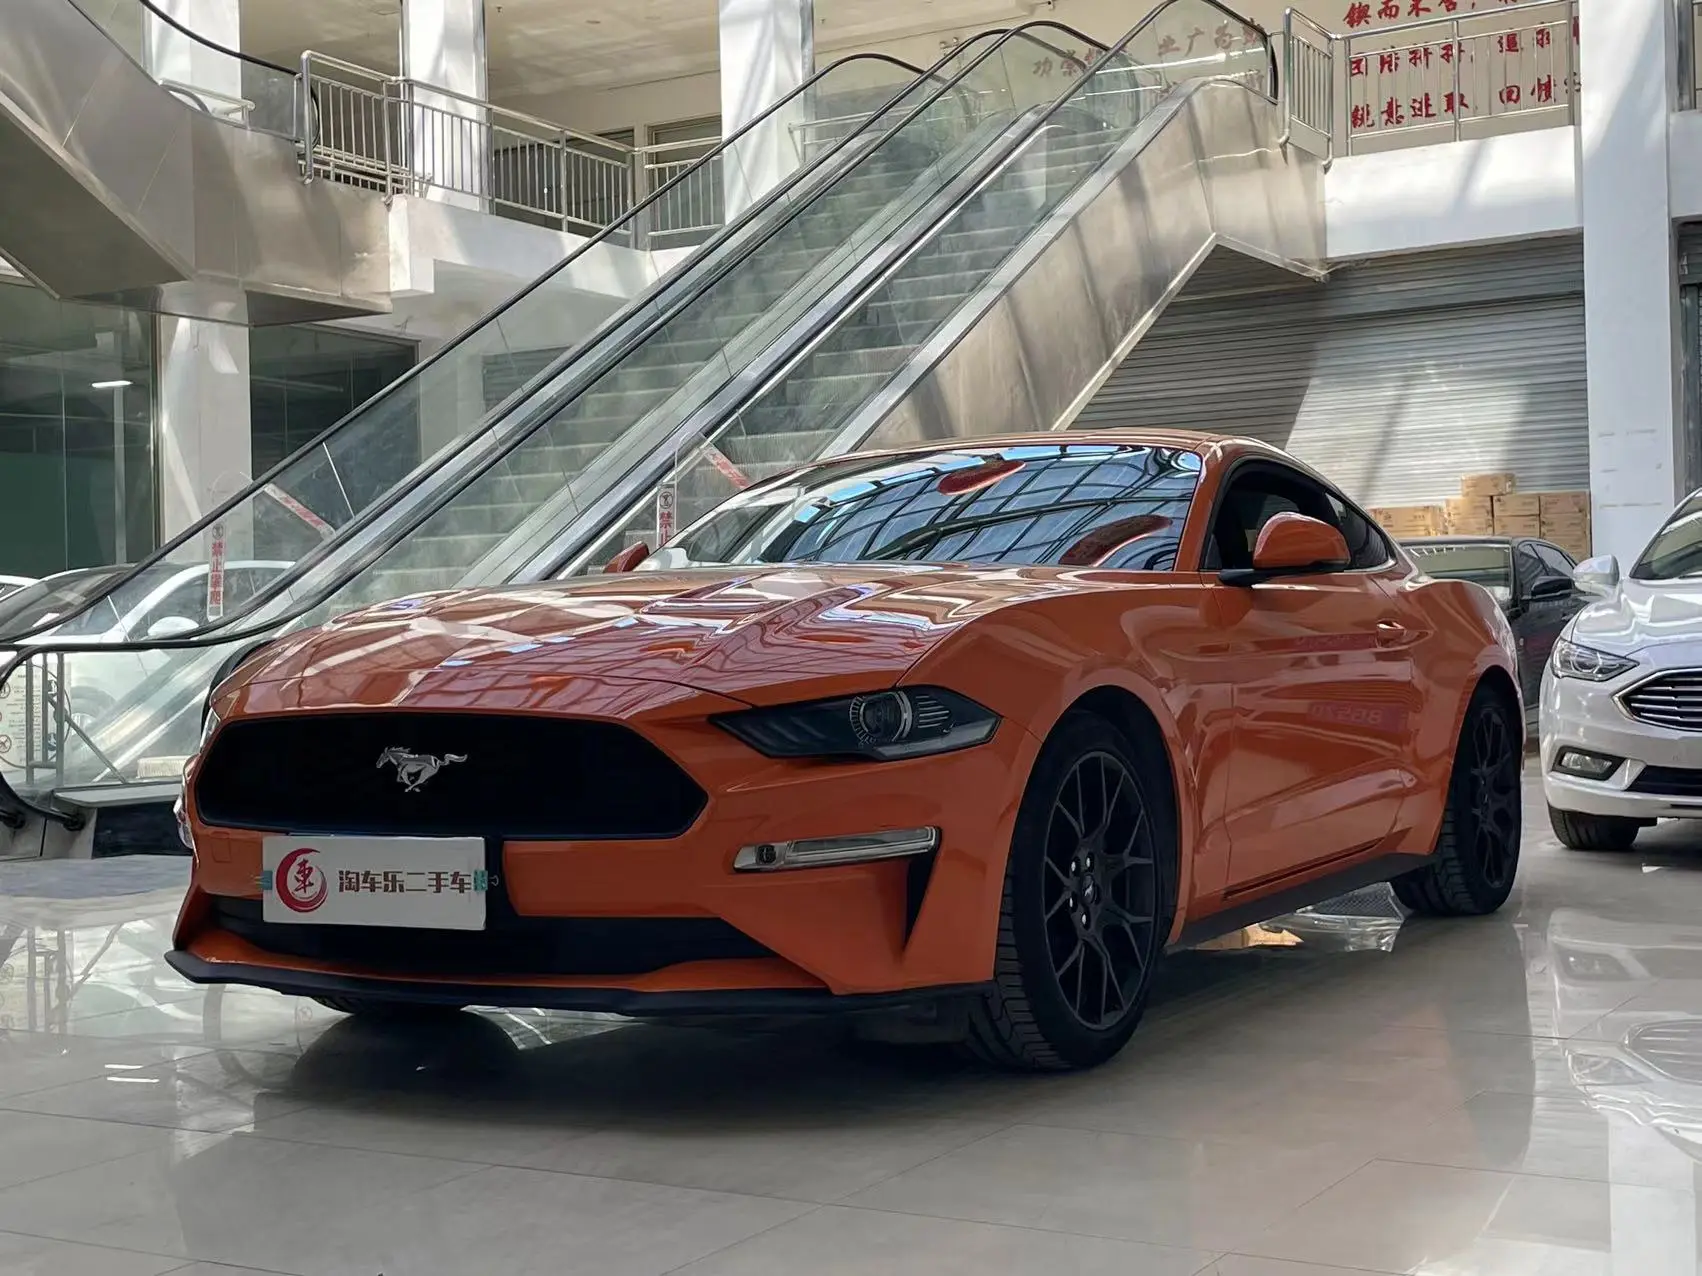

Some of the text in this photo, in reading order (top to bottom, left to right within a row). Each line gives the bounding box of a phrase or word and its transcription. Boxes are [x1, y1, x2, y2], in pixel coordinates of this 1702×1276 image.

[338, 869, 472, 894] 淘车乐二手车
